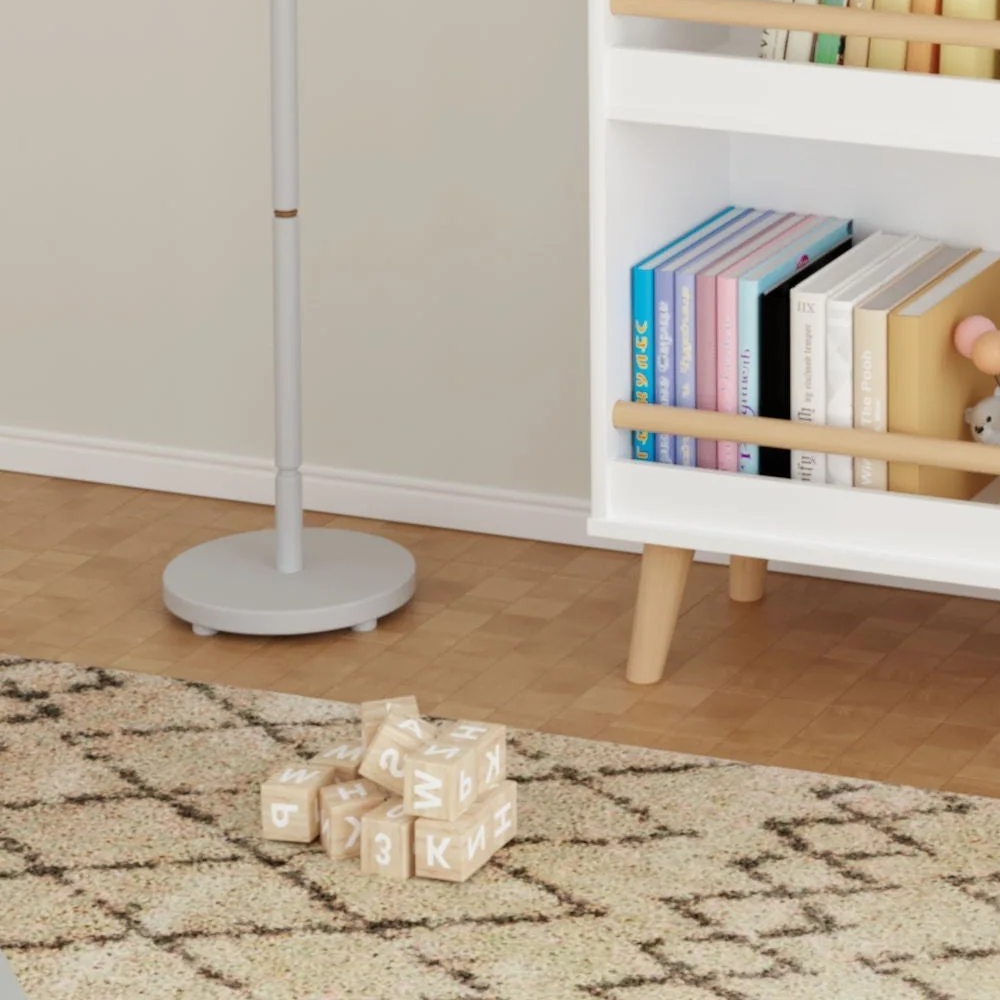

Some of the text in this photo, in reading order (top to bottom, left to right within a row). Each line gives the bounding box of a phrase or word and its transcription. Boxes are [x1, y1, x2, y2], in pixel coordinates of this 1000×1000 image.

[860, 350, 873, 392] Pooh
[860, 393, 872, 426] The
[426, 834, 452, 869] K
